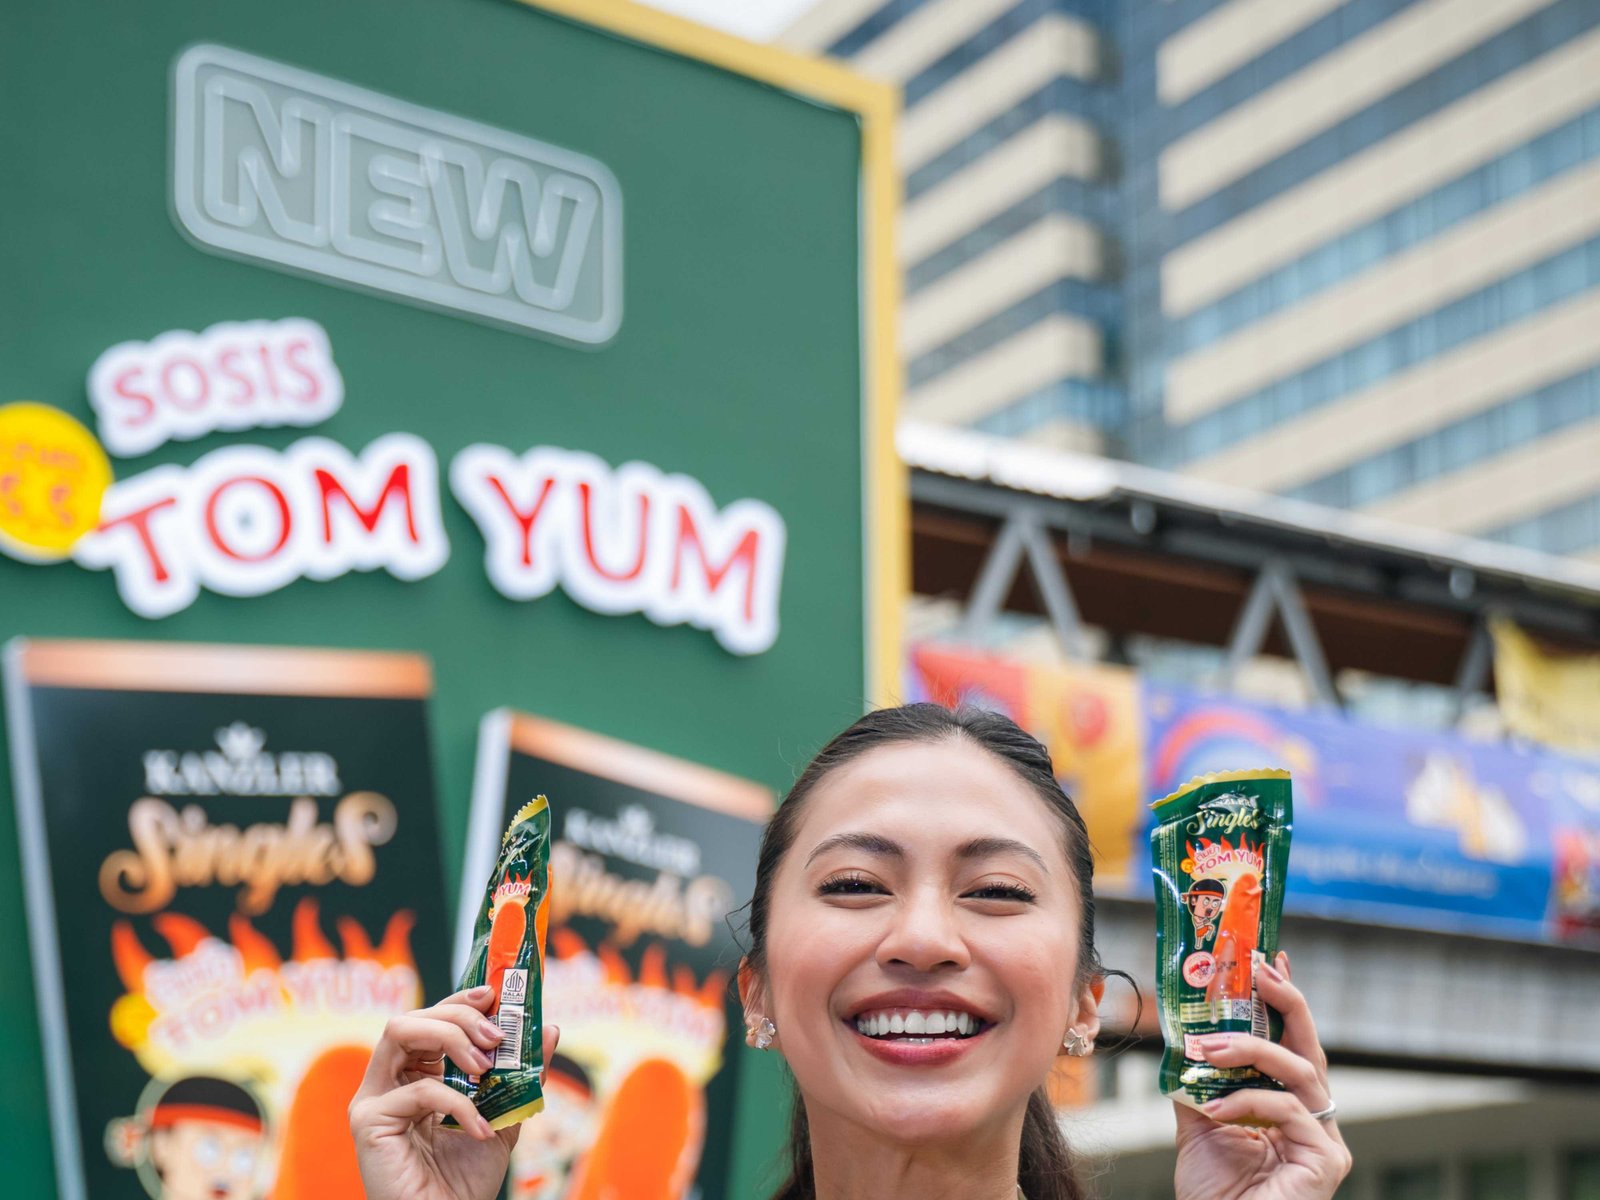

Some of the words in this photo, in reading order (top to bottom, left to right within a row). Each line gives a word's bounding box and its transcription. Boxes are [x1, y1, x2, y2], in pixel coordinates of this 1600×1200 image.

[203, 73, 601, 312] NEW
[112, 337, 325, 428] SOSIS
[96, 463, 421, 586] TOM
[486, 475, 760, 624] YUM
[142, 750, 342, 797] KANZLER
[500, 883, 530, 896] YUM
[1195, 851, 1231, 874] TOM
[1236, 850, 1263, 871] YUM
